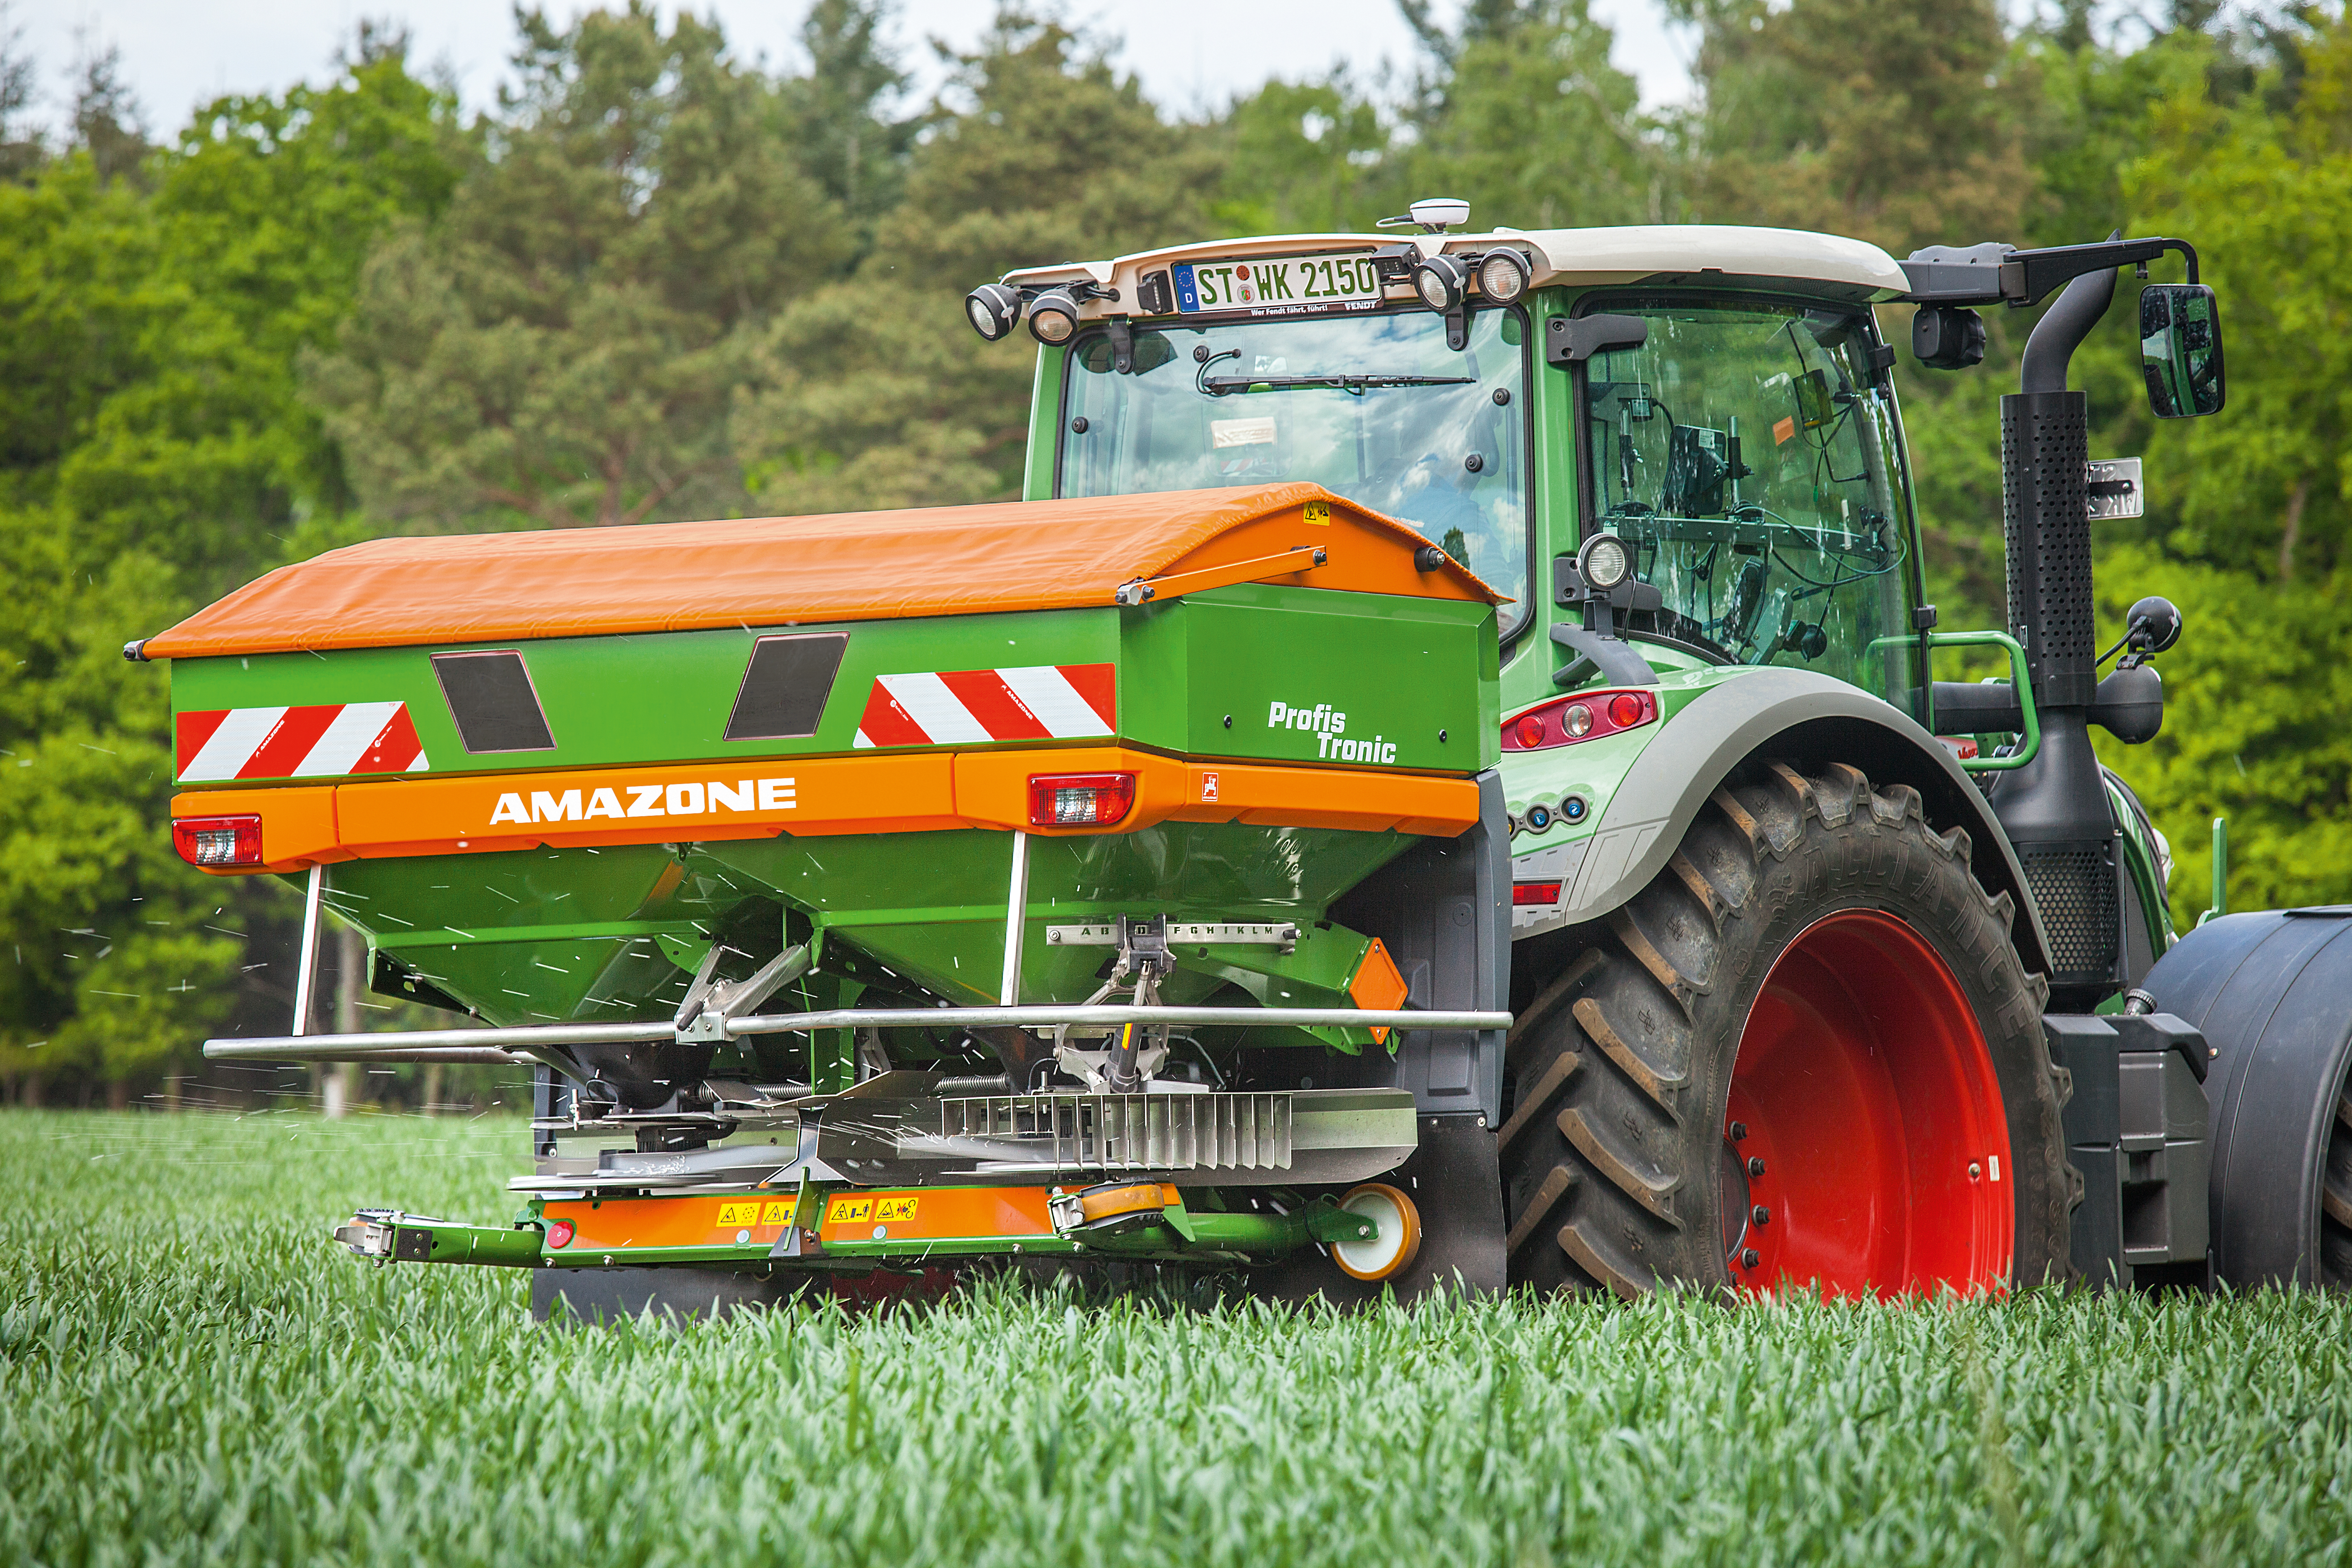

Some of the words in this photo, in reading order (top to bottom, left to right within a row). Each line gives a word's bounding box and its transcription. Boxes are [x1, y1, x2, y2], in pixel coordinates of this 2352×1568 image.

[1198, 267, 1232, 304] ST
[1253, 263, 1294, 300] WK
[1300, 258, 1374, 297] 2150
[1185, 293, 1193, 303] D
[1287, 306, 1306, 314] fährt,
[1344, 301, 1377, 311] FENDT
[1006, 691, 1033, 720] AMAZONE
[1268, 701, 1346, 733] Profis
[260, 720, 285, 751] AMAZONE
[1317, 732, 1396, 763] Tronic
[489, 778, 797, 825] AMAZONE
[1802, 833, 2034, 1039] ALLIANCE
